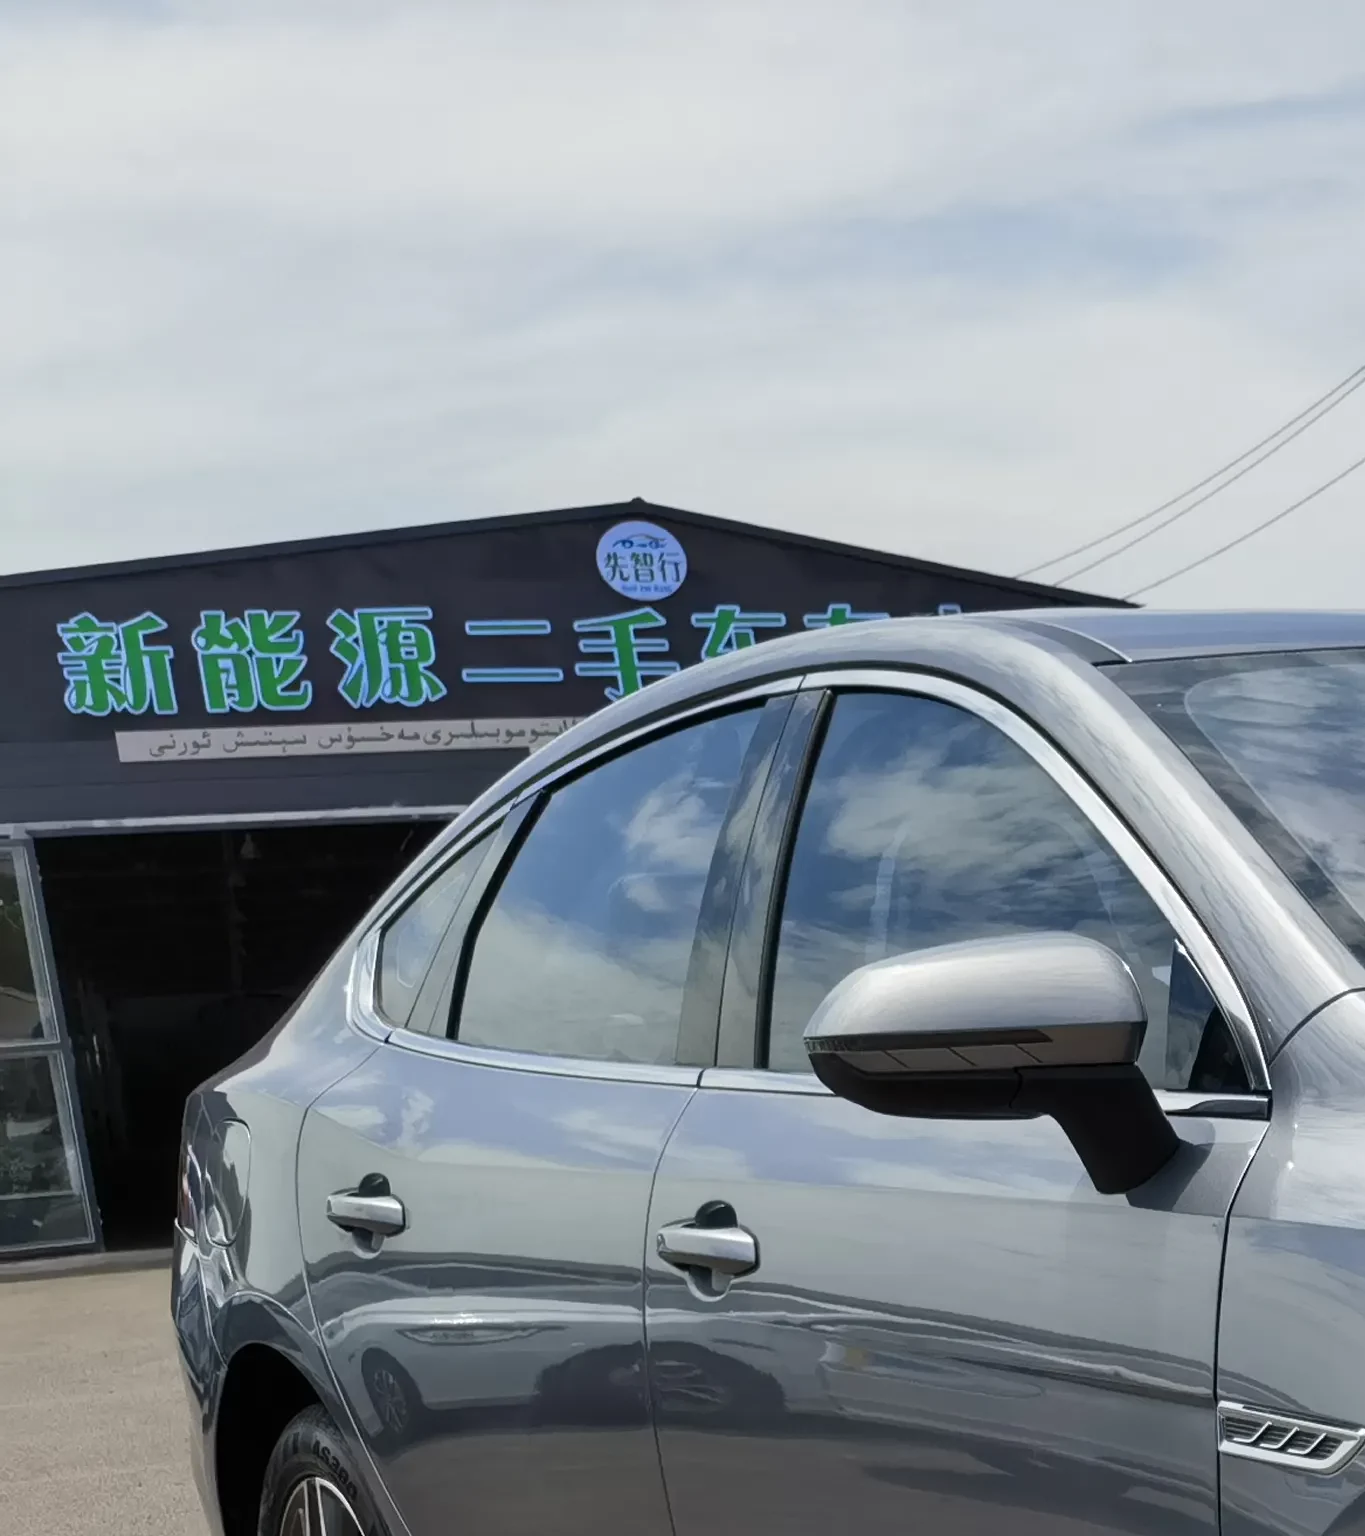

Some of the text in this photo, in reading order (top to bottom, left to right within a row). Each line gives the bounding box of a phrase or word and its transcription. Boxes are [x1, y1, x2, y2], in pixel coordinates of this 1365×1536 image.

[605, 551, 681, 583] 先智行
[57, 603, 963, 716] 新能源二手车
